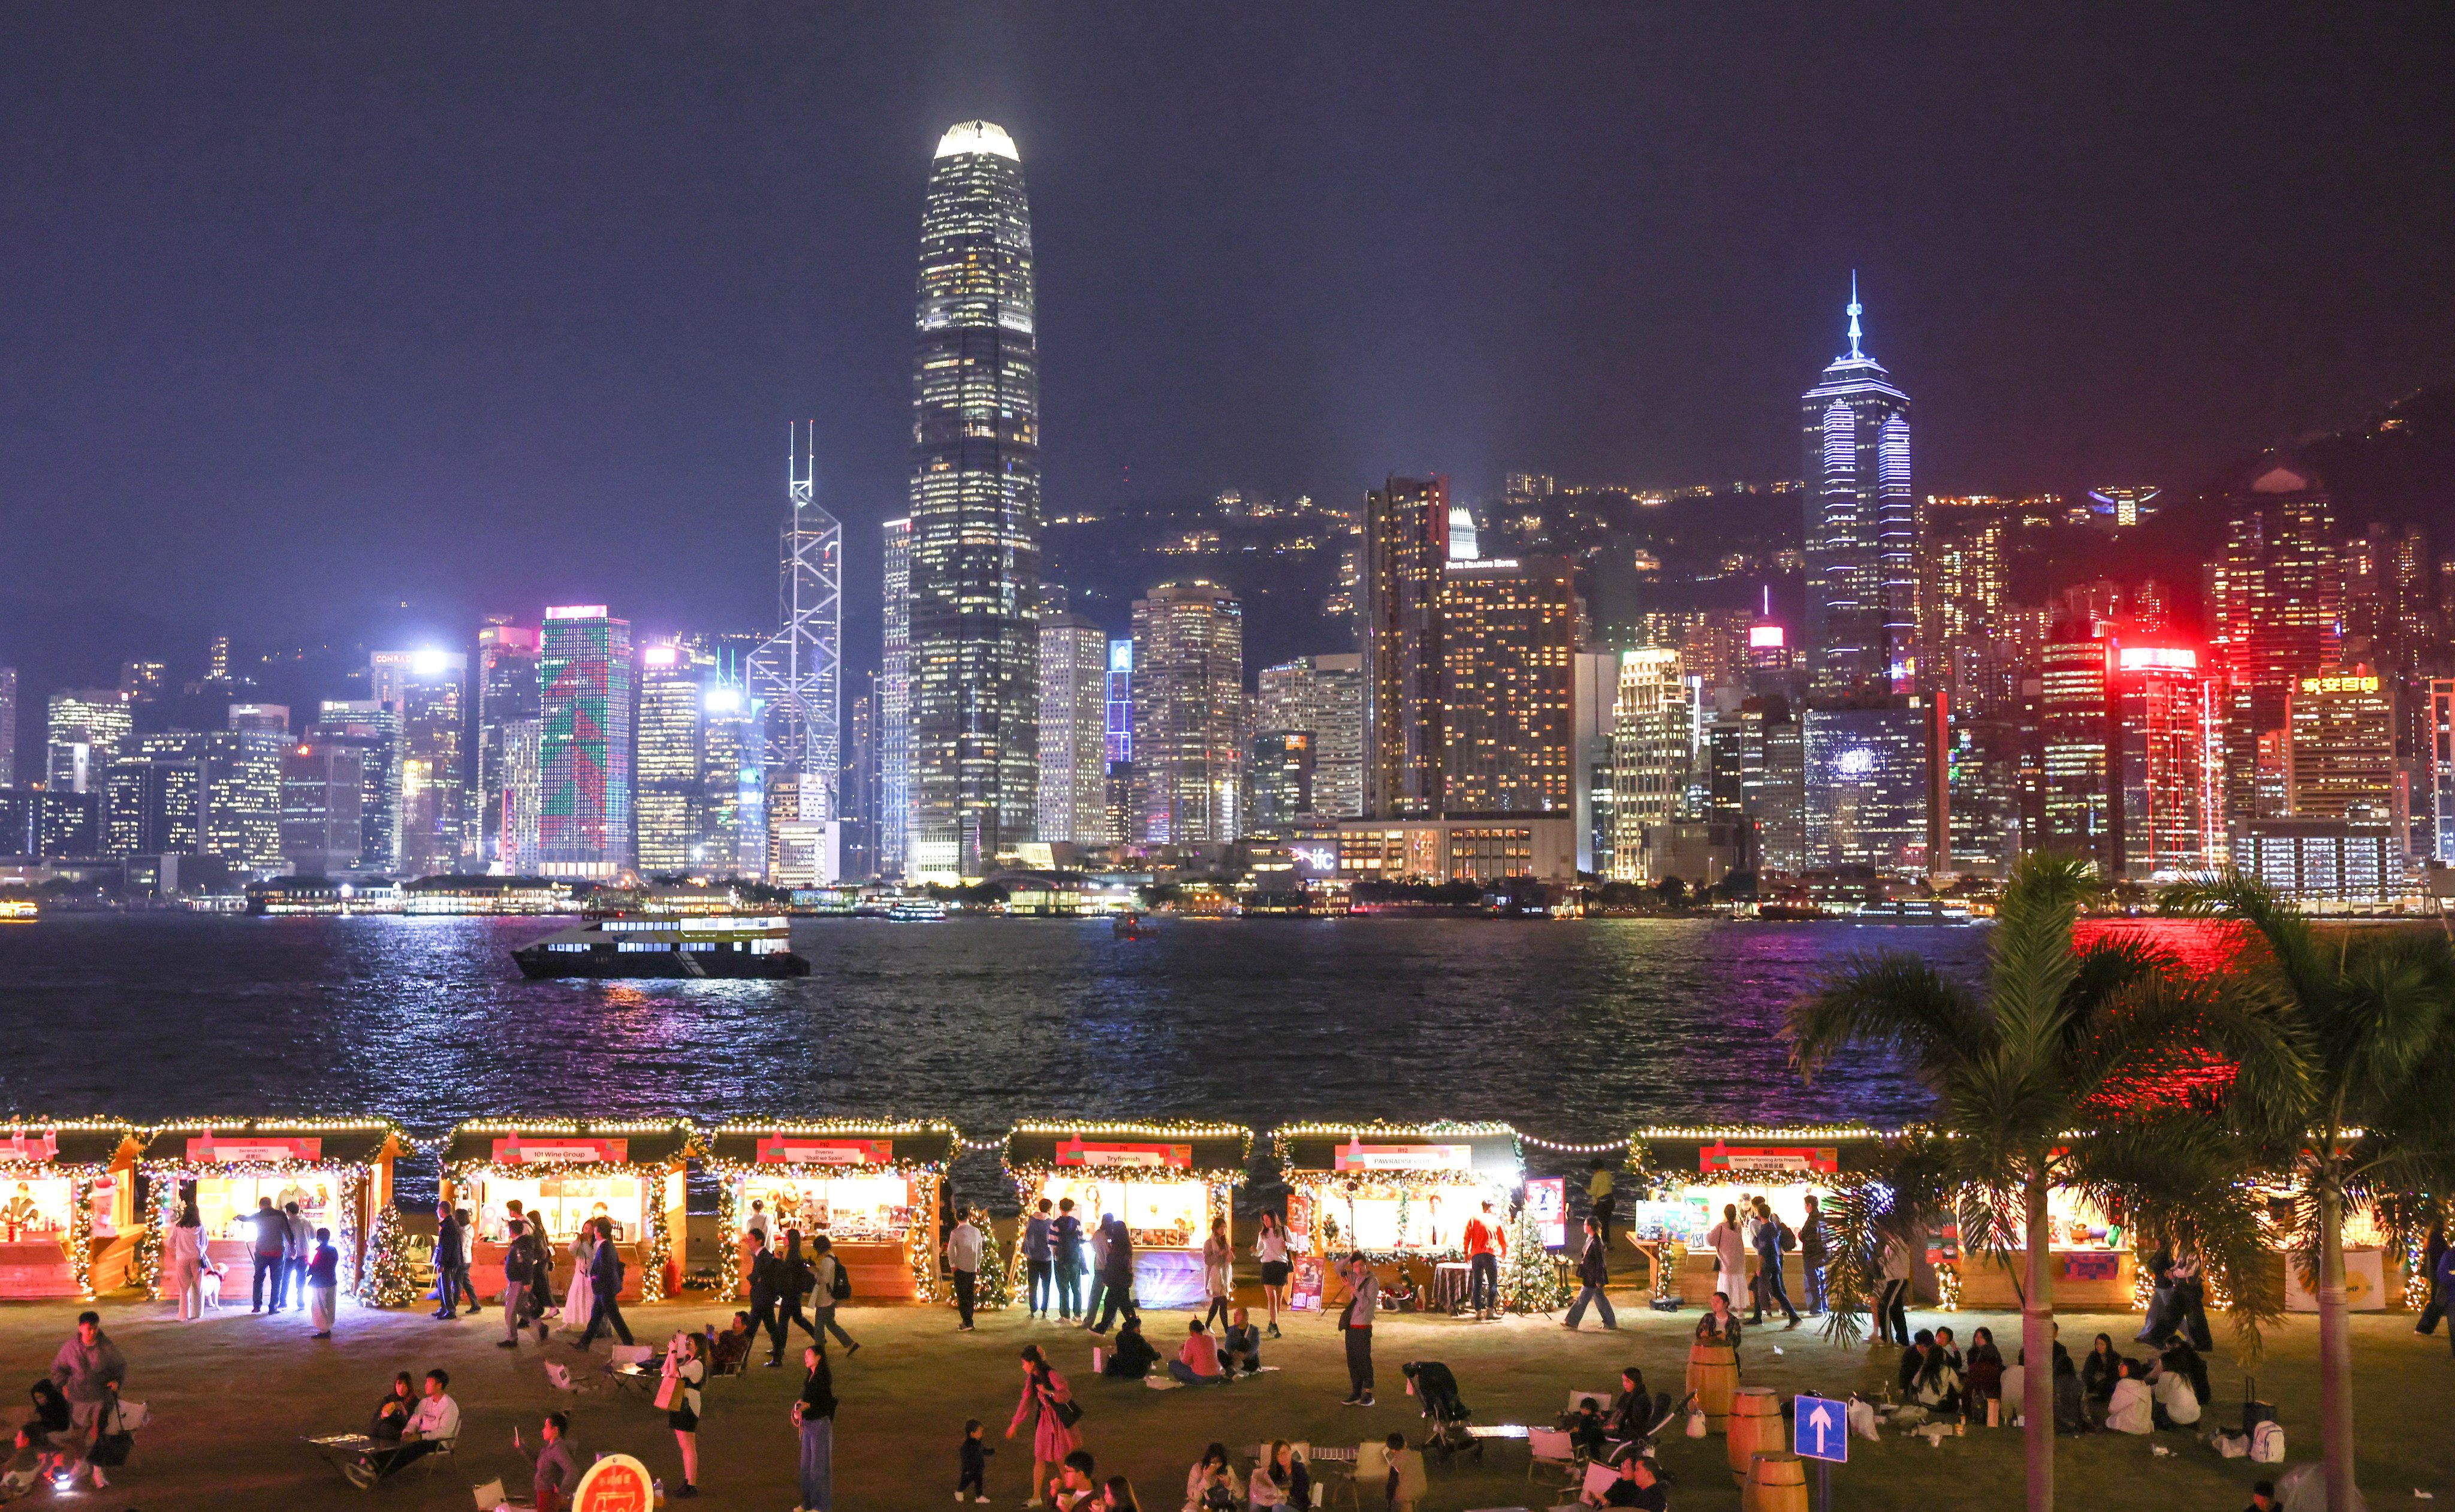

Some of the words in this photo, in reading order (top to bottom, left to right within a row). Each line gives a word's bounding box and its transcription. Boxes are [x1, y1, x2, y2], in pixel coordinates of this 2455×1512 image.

[2301, 677, 2378, 694] 永安百貨
[1313, 848, 1334, 870] ifc
